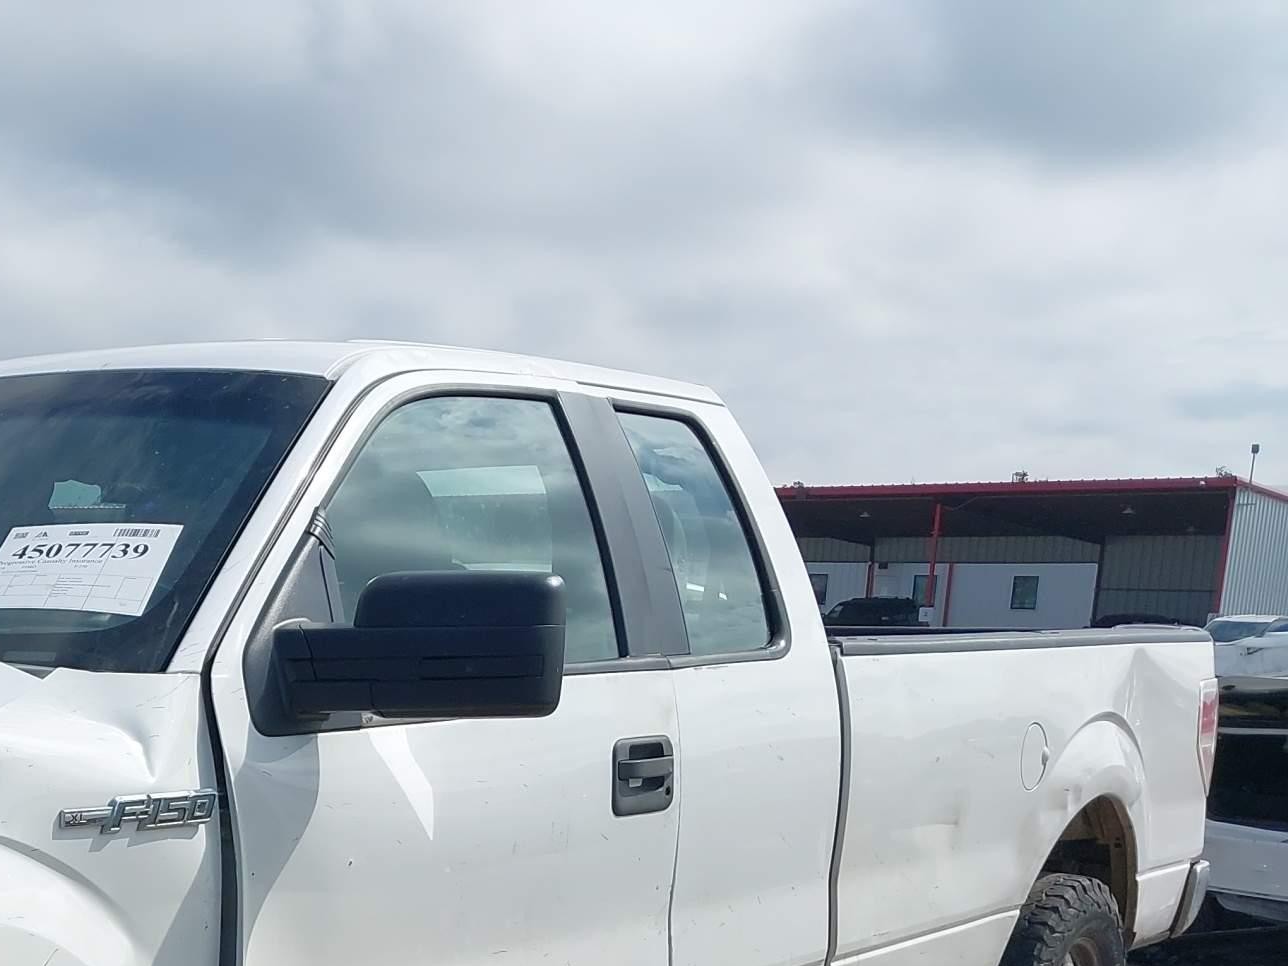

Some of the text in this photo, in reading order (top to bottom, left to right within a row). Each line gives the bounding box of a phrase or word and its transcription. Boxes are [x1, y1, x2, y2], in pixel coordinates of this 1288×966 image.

[12, 543, 149, 560] 45077739
[69, 813, 87, 825] XL
[100, 790, 218, 834] F-150
